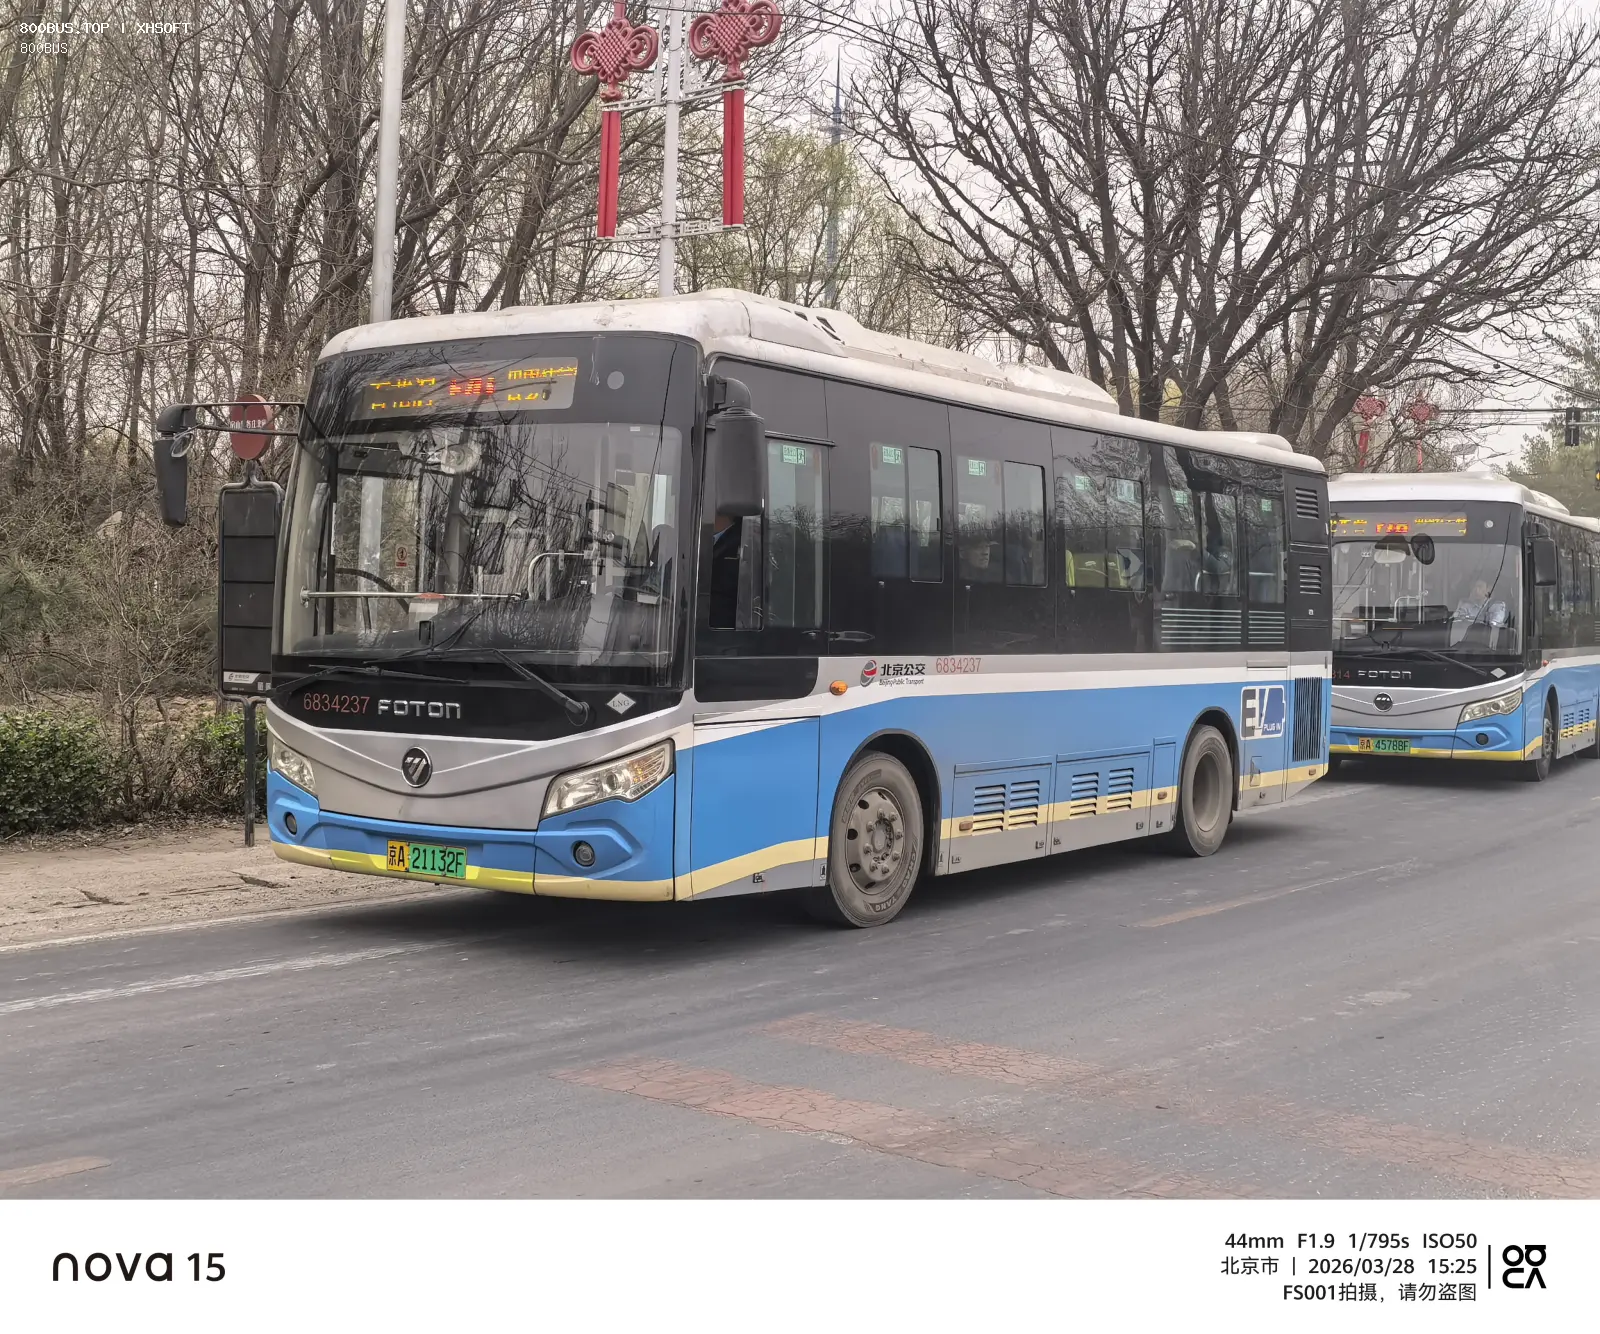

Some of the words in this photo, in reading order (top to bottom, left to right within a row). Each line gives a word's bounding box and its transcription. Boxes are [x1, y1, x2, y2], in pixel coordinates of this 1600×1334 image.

[880, 663, 926, 676] 北京公交
[936, 657, 981, 674] 6834237
[1357, 669, 1412, 680] FOTON
[303, 692, 370, 714] 6834237
[378, 699, 461, 718] FOTON
[612, 699, 630, 708] LNG
[1263, 723, 1276, 732] PLUG
